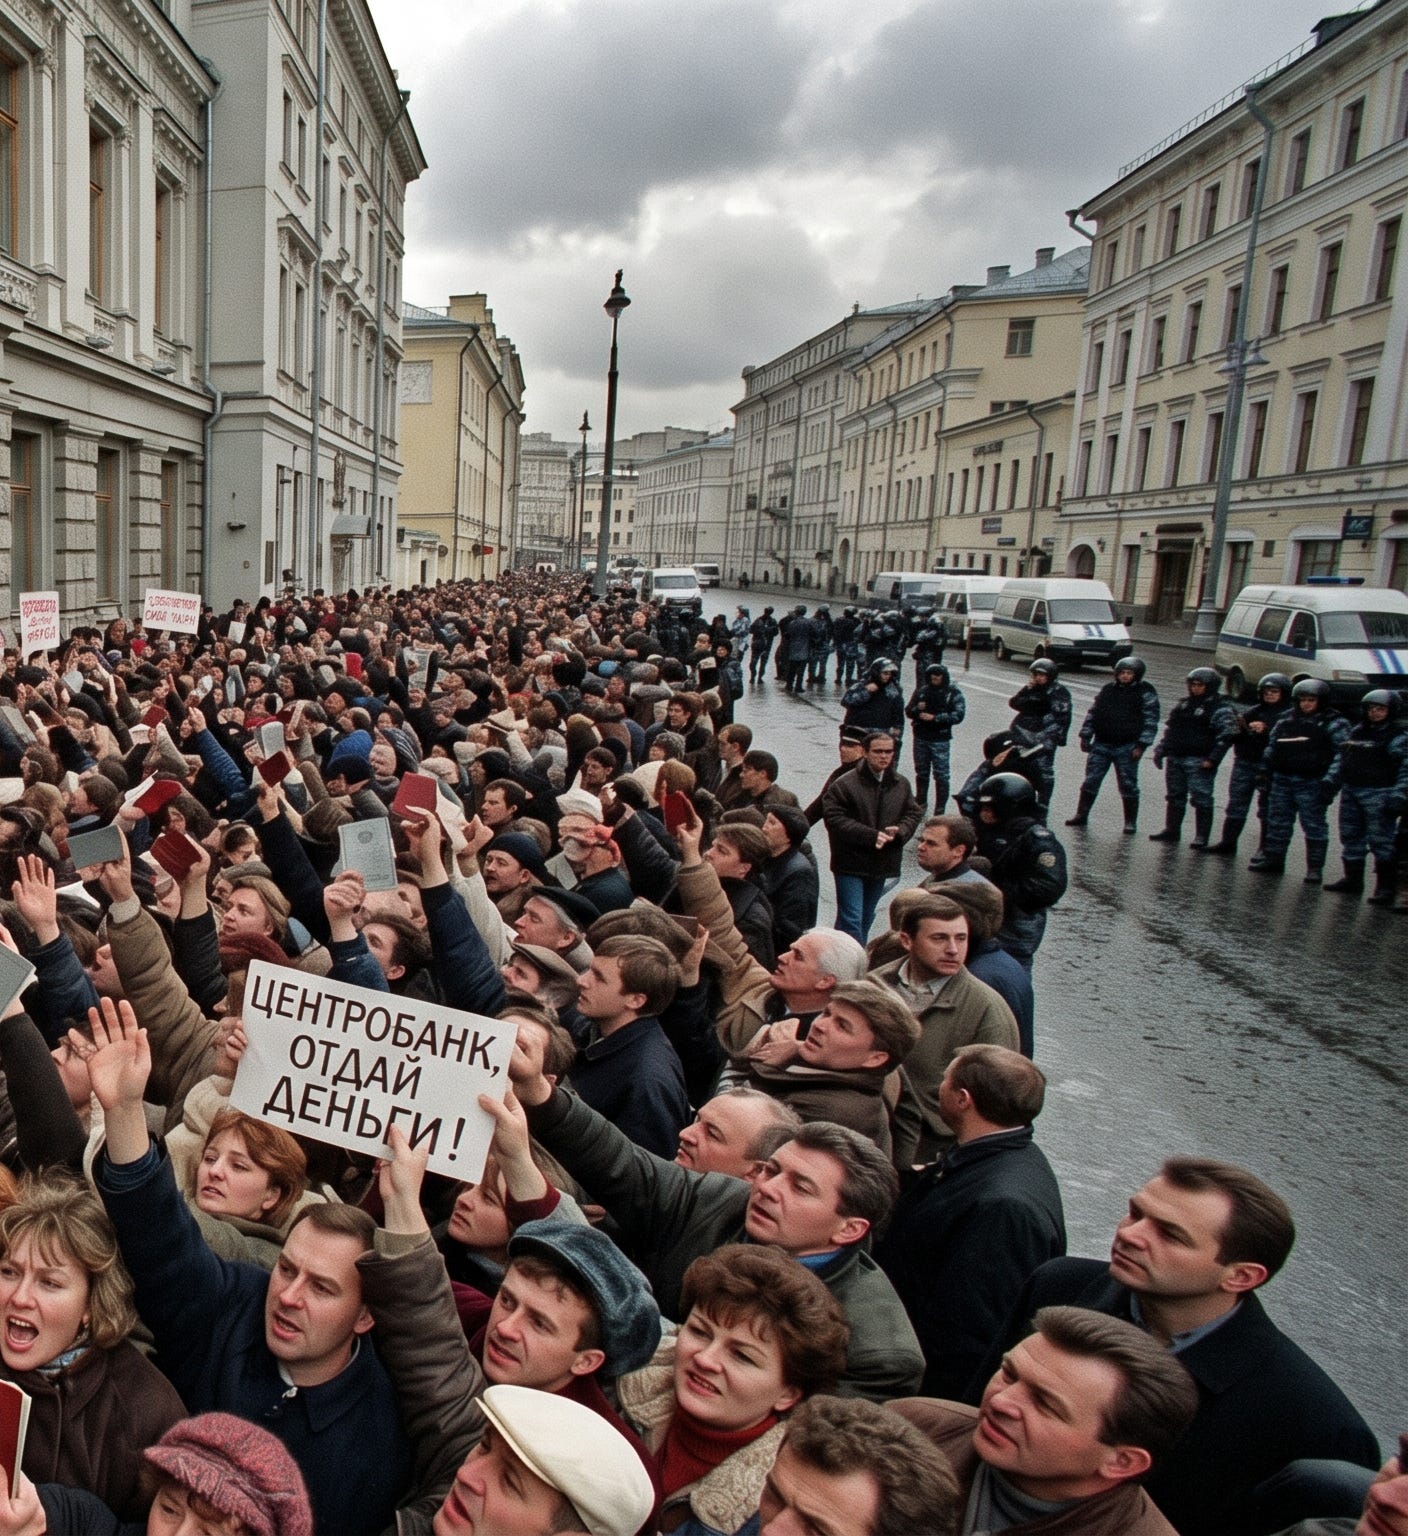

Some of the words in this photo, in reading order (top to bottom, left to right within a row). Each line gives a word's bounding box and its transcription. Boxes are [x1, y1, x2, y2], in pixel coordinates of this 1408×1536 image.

[251, 975, 500, 1077] ЦЕНТРОБАНК,
[290, 1034, 422, 1099] ОТДАЙ
[262, 1076, 466, 1161] ДЕНЬГИ!
